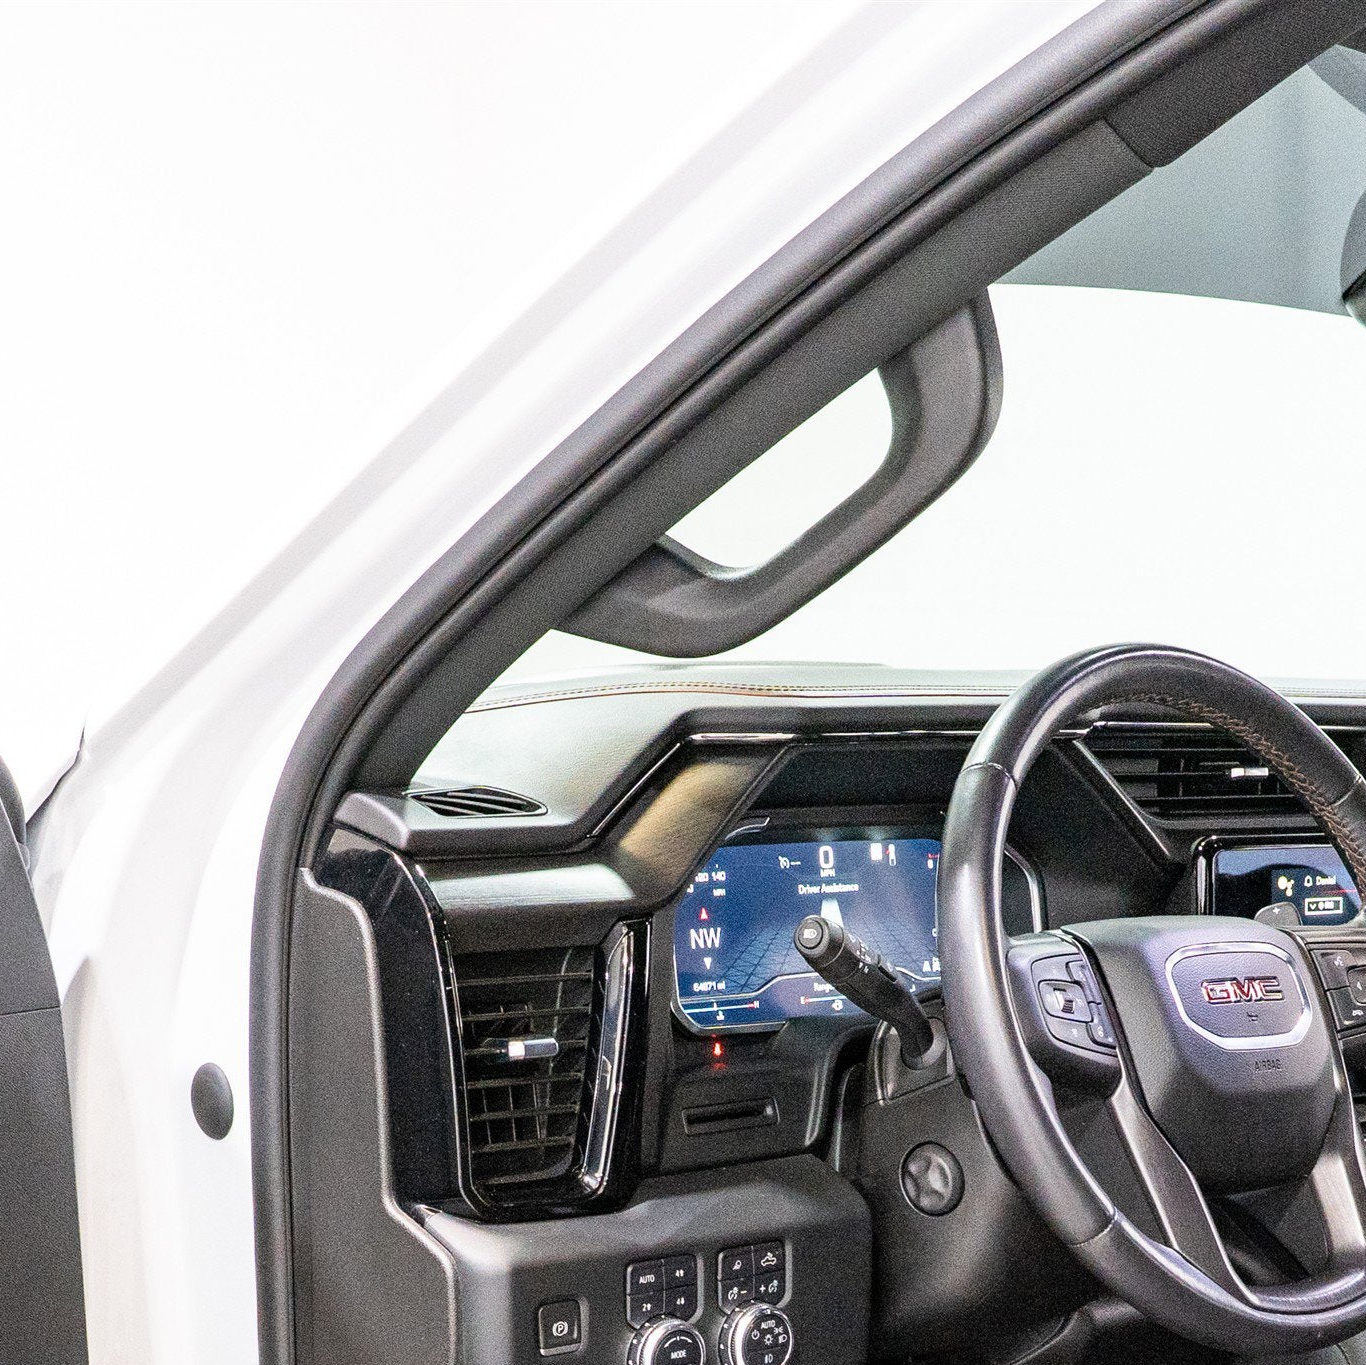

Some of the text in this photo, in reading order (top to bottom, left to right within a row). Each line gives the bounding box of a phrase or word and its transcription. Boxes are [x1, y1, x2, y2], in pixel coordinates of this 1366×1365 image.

[797, 882, 860, 895] Driver Assistance
[689, 927, 721, 950] NW
[1201, 976, 1285, 1005] GMC
[639, 1275, 655, 1284] AUTO
[760, 1320, 776, 1330] AUTO
[670, 1350, 687, 1360] MODE
